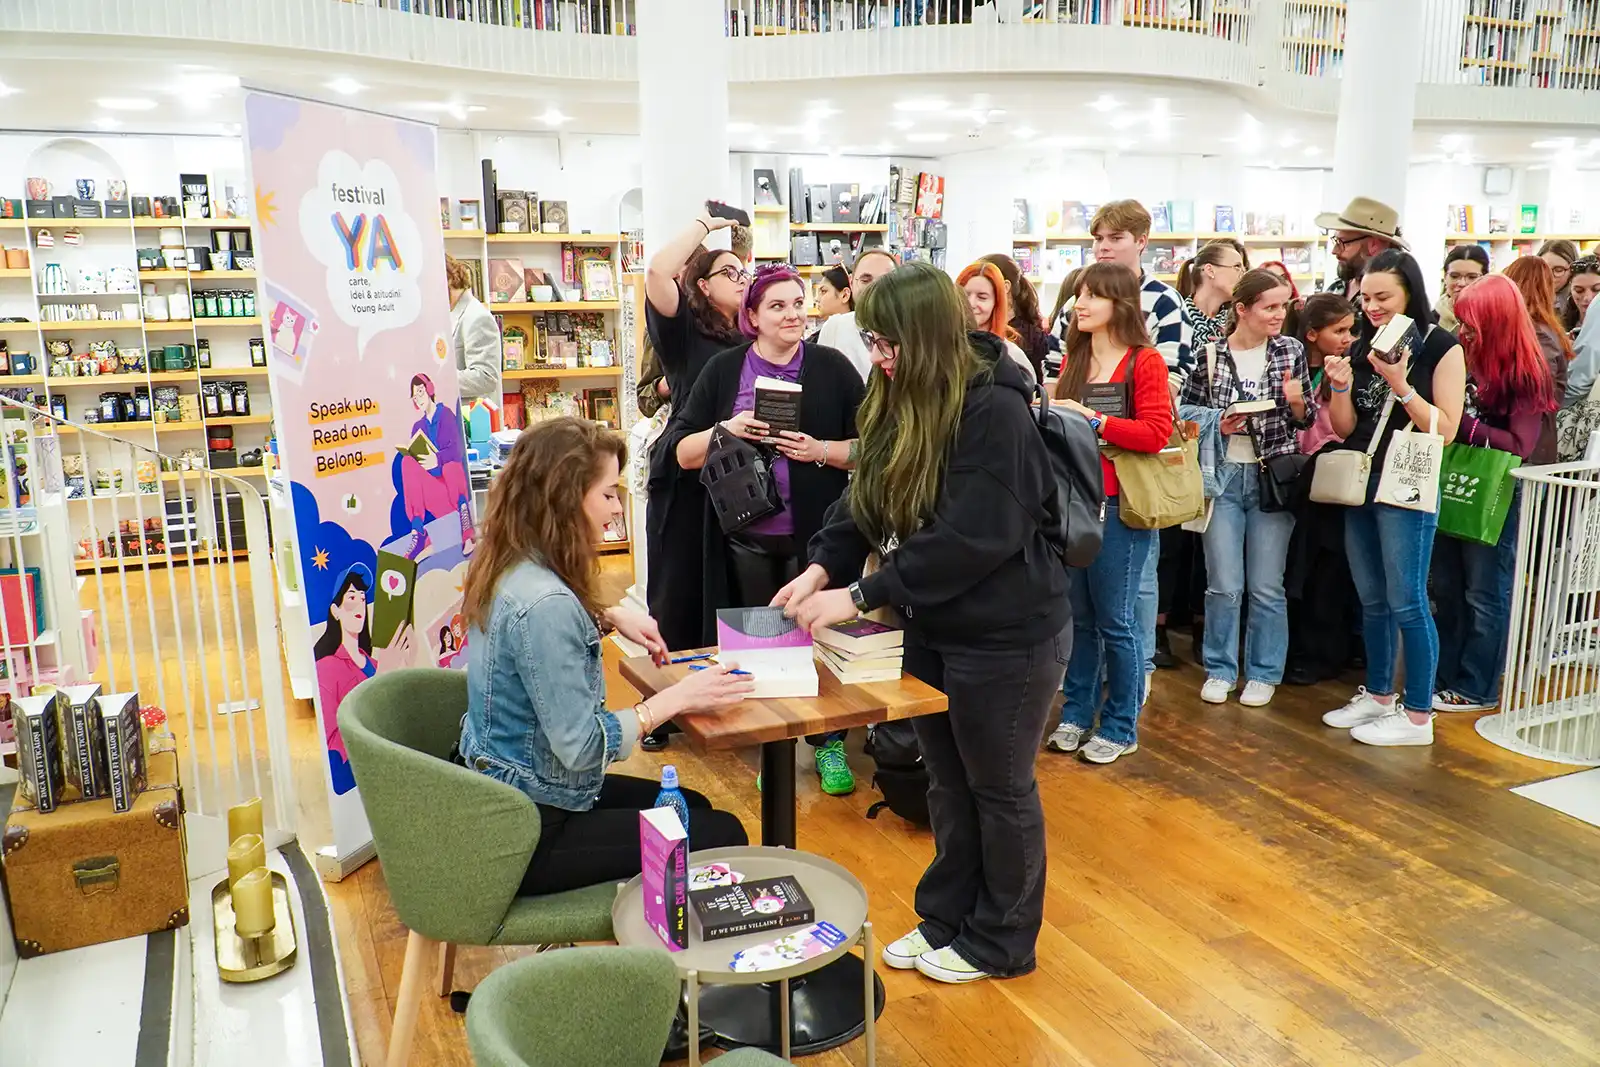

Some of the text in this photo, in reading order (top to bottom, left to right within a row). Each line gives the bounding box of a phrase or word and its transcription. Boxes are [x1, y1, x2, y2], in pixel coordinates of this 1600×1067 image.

[332, 183, 385, 206] festival
[331, 211, 405, 273] YA
[349, 277, 371, 287] carte,
[350, 290, 365, 300] idei
[366, 290, 373, 299] &
[352, 302, 395, 314] Young Adult
[1239, 378, 1256, 388] rin
[310, 397, 376, 420] Speak up.
[313, 423, 371, 446] Read on.
[316, 450, 367, 472] Belong.
[715, 896, 730, 910] WE
[726, 892, 741, 911] WERE
[732, 885, 756, 917] VILLAINS
[729, 924, 747, 932] WERE
[748, 919, 777, 929] VILLAINS
